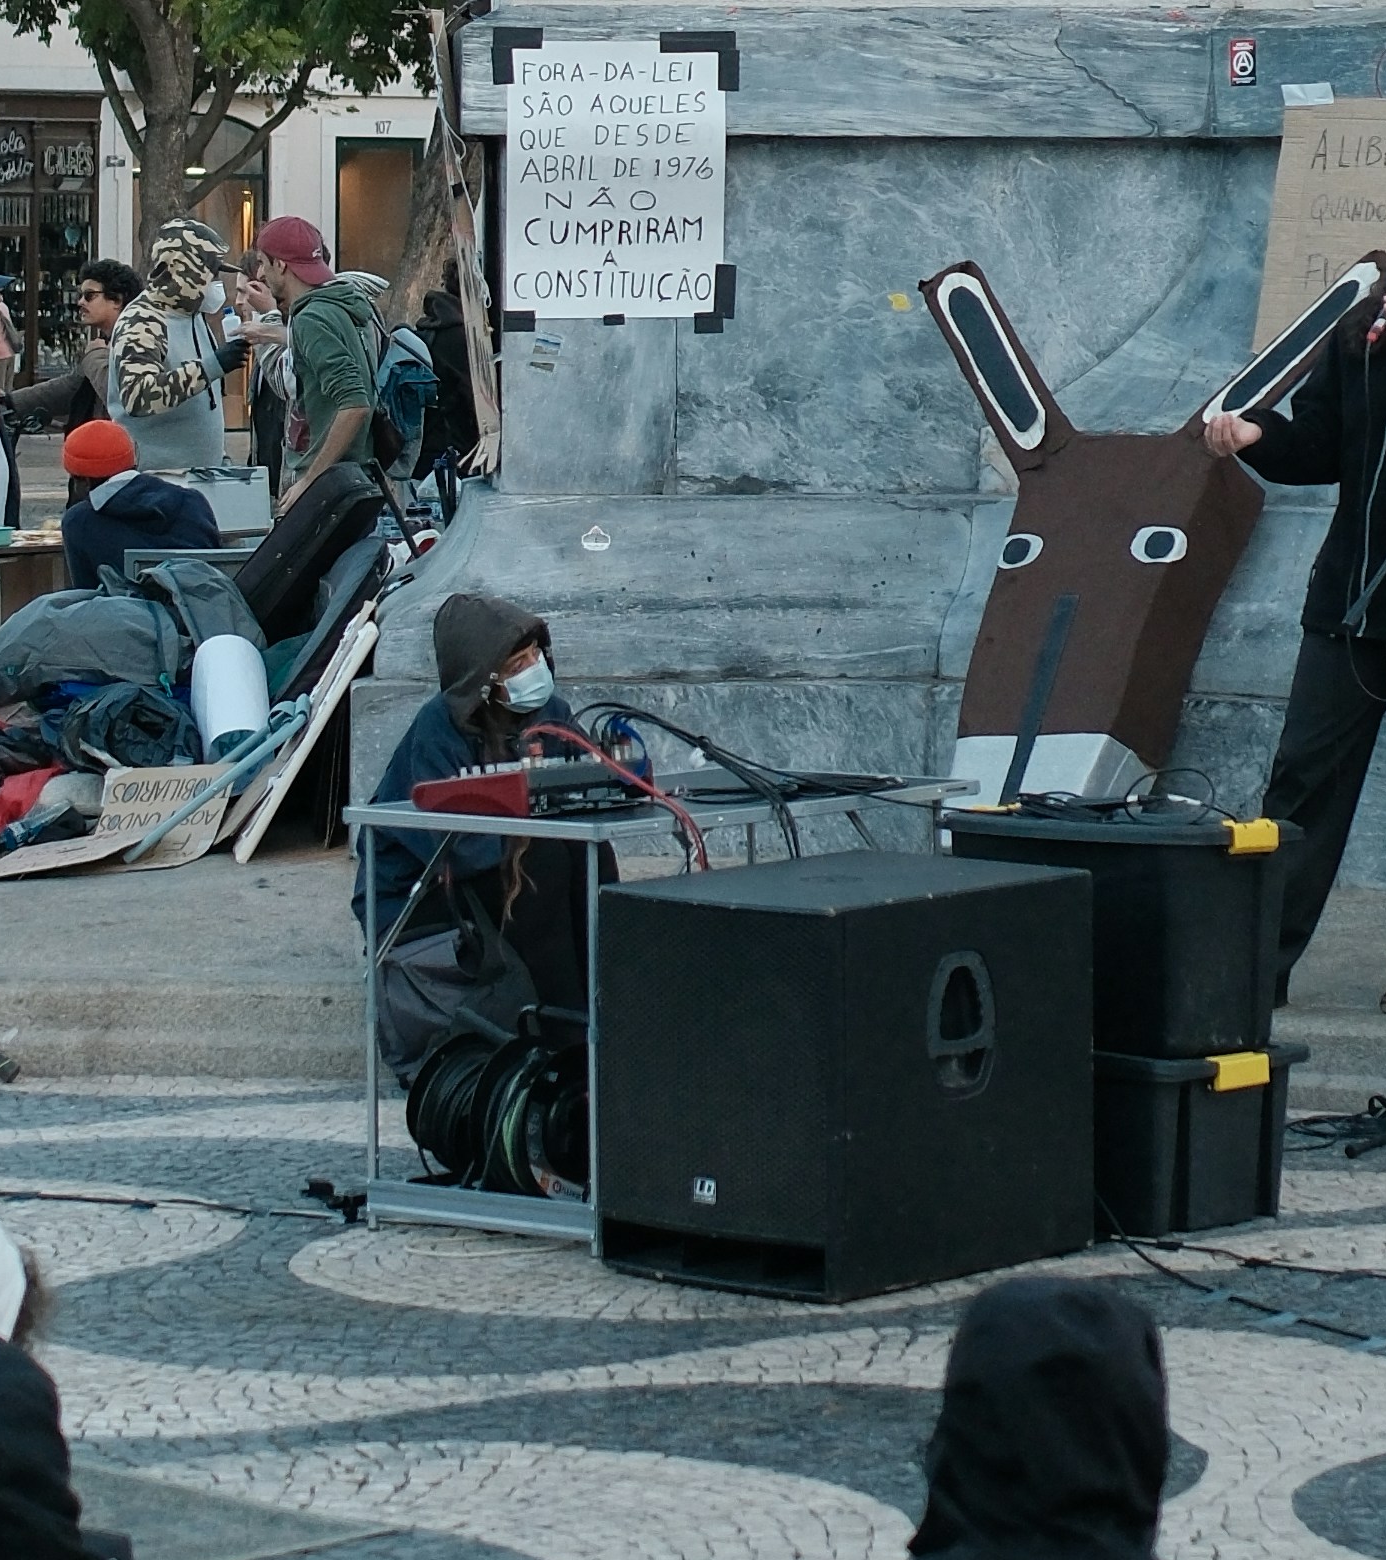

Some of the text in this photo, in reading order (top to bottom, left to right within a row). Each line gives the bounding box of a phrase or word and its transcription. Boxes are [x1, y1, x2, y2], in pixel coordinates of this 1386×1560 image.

[520, 60, 694, 86] FORA-DA-LEI
[522, 91, 707, 119] SÃO AQUELES
[374, 120, 392, 135] 107
[519, 123, 697, 151] QUE DESDE
[43, 141, 95, 176] CAFÉS
[1310, 128, 1329, 171] A
[519, 154, 715, 184] ABRIL DE 1976
[544, 185, 658, 211] NÃO
[523, 216, 704, 247] CUMPRIRAM
[602, 250, 619, 267] A
[513, 268, 713, 303] CONSTITUIÇÃO
